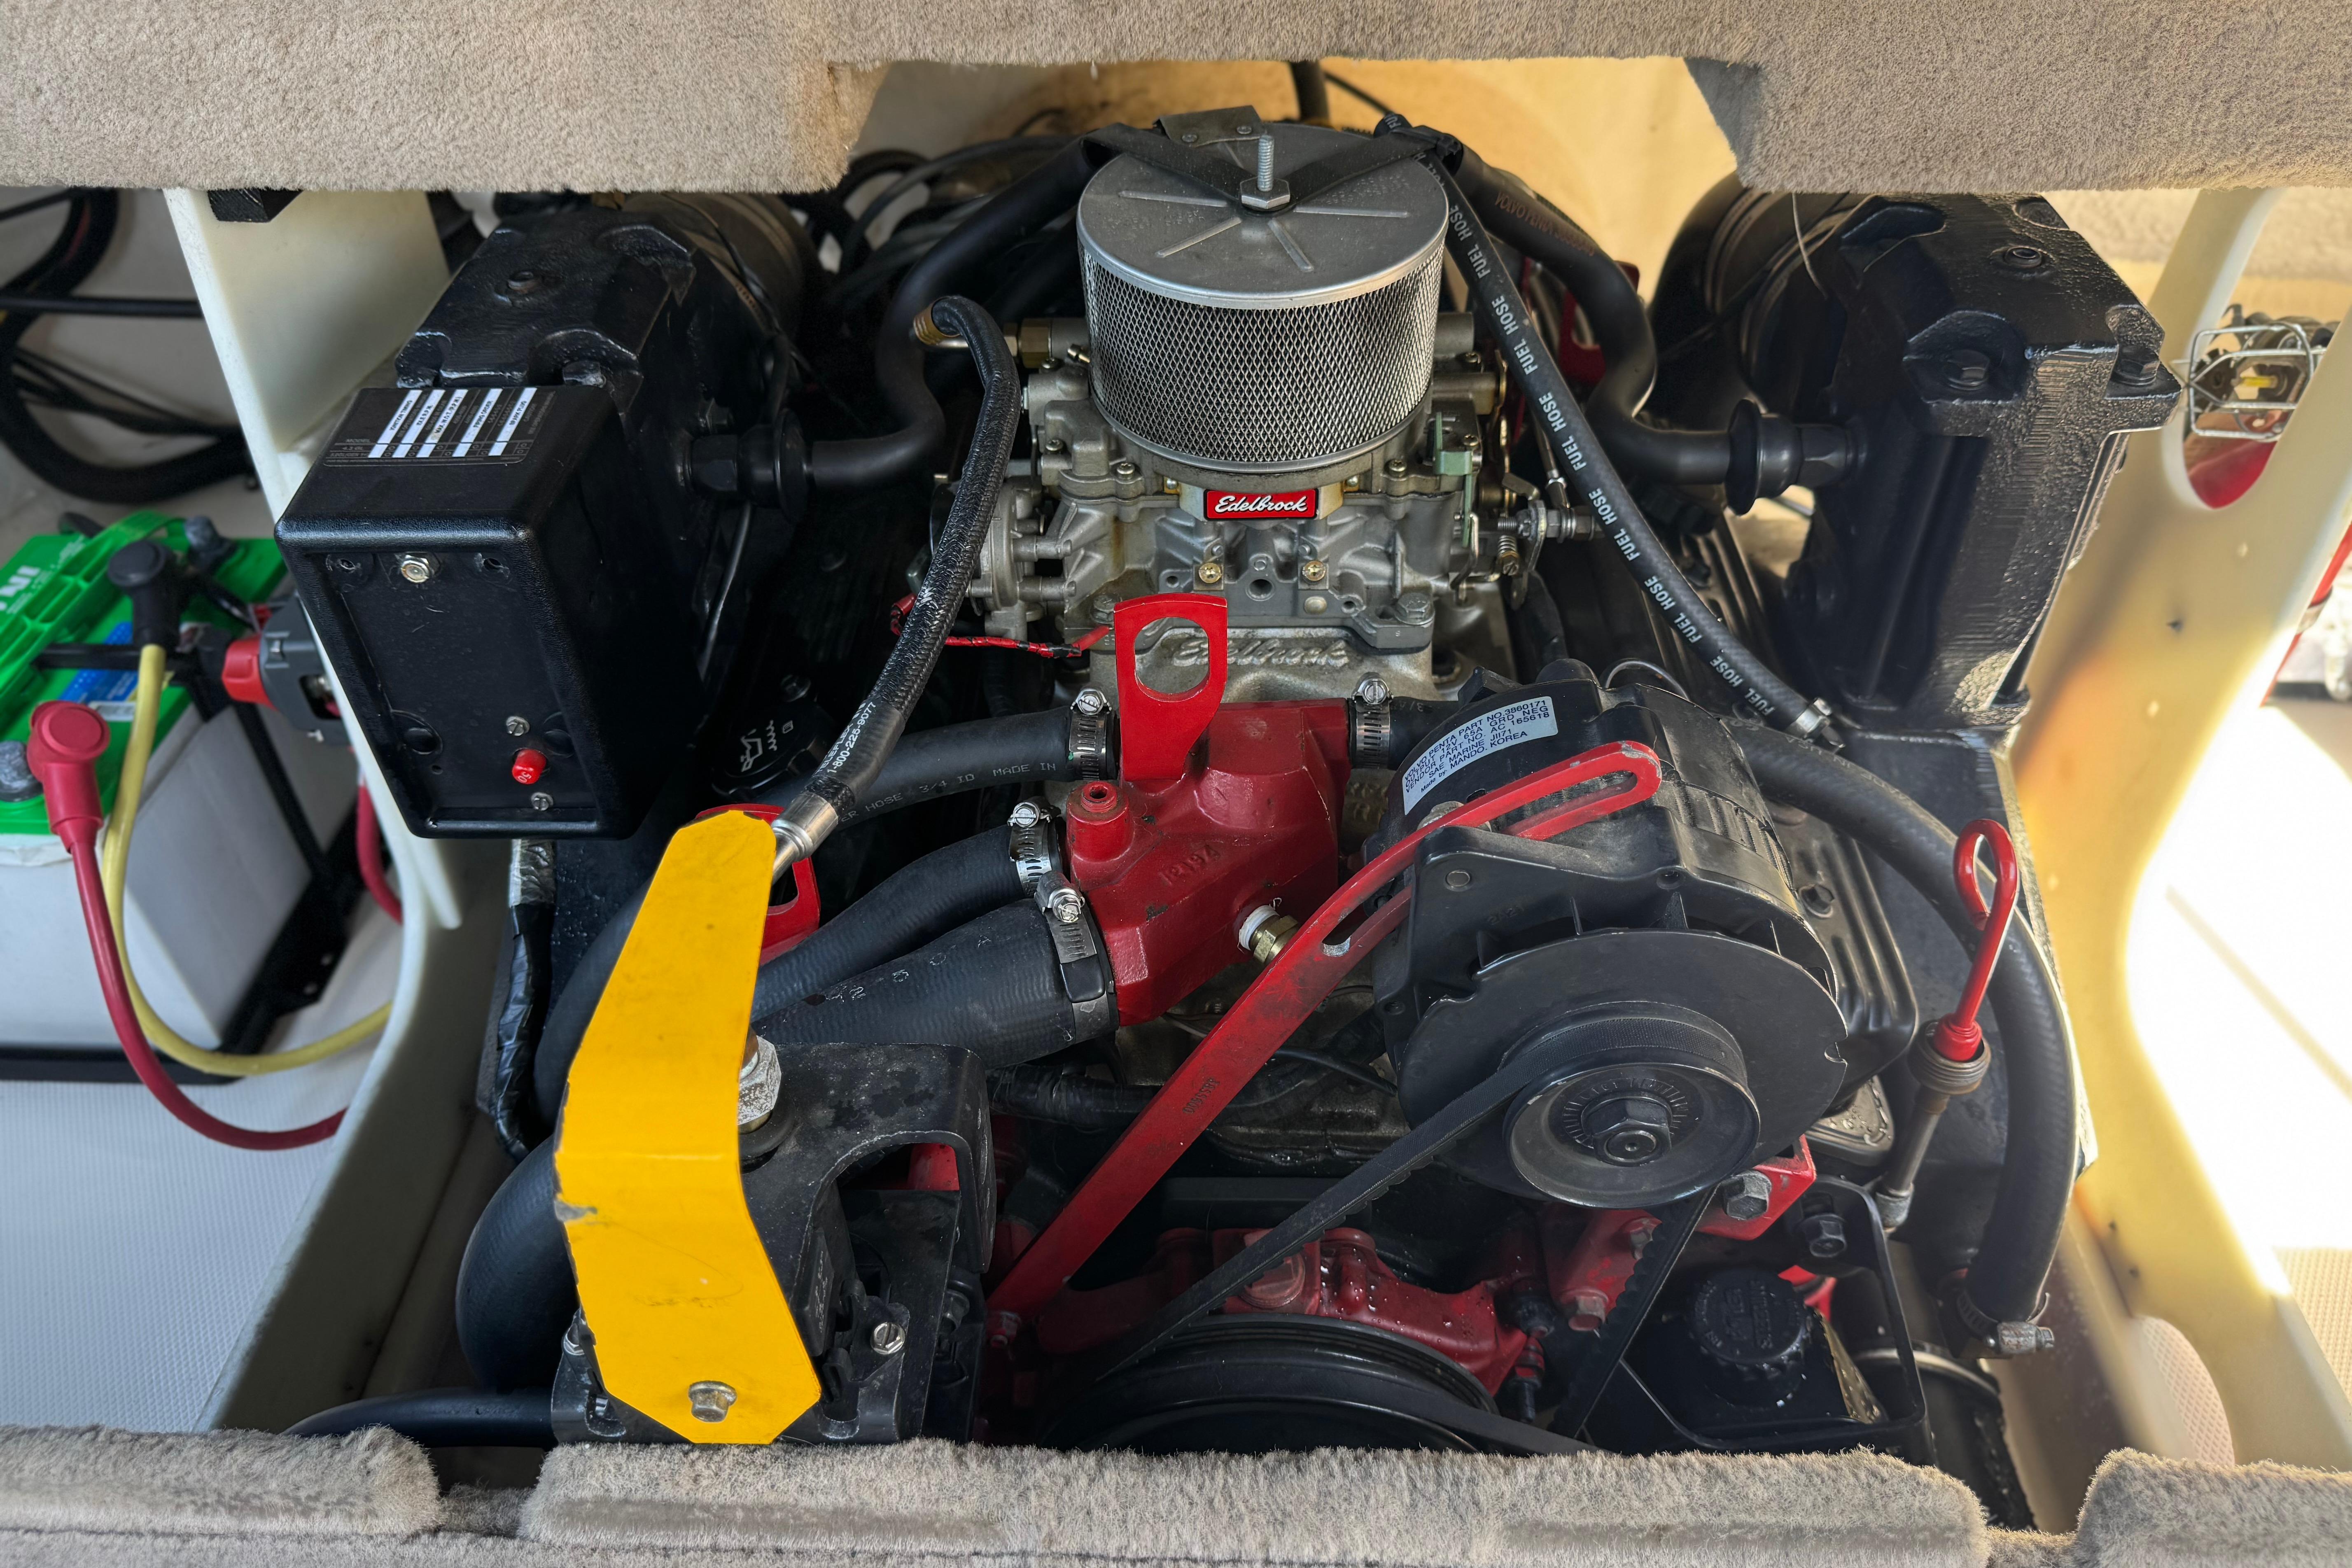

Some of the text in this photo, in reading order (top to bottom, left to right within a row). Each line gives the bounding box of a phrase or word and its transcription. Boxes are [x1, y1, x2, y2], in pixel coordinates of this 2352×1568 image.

[1449, 204, 1490, 278] FUEL HOSE
[1491, 295, 1538, 375] FUEL HOSE
[1538, 392, 1587, 471] FUEL HOSE
[1215, 495, 1308, 512] Edelbrock
[1589, 488, 1640, 561] FUEL HOSE
[1644, 576, 1703, 643] FUEL HOSE
[1710, 655, 1776, 716] FUEL HOSE
[827, 702, 876, 773] 1-800-225-9077
[1405, 705, 1549, 788] OUTPUT 12V 65A GRD NEG
[1405, 756, 1427, 781] VOLVO
[1429, 735, 1456, 757] PENTA
[1459, 719, 1483, 736] PART
[1406, 712, 1550, 793] VENDOR PART NO. AC 165618
[1421, 778, 1436, 793] Made
[1450, 746, 1488, 769] MANDO.
[1490, 731, 1528, 748] KOREA
[1429, 762, 1444, 778] SAE
[1449, 739, 1485, 763] MARINE
[518, 772, 532, 784] 50
[866, 762, 1057, 812] HOSE 3/4 ID MADE IN
